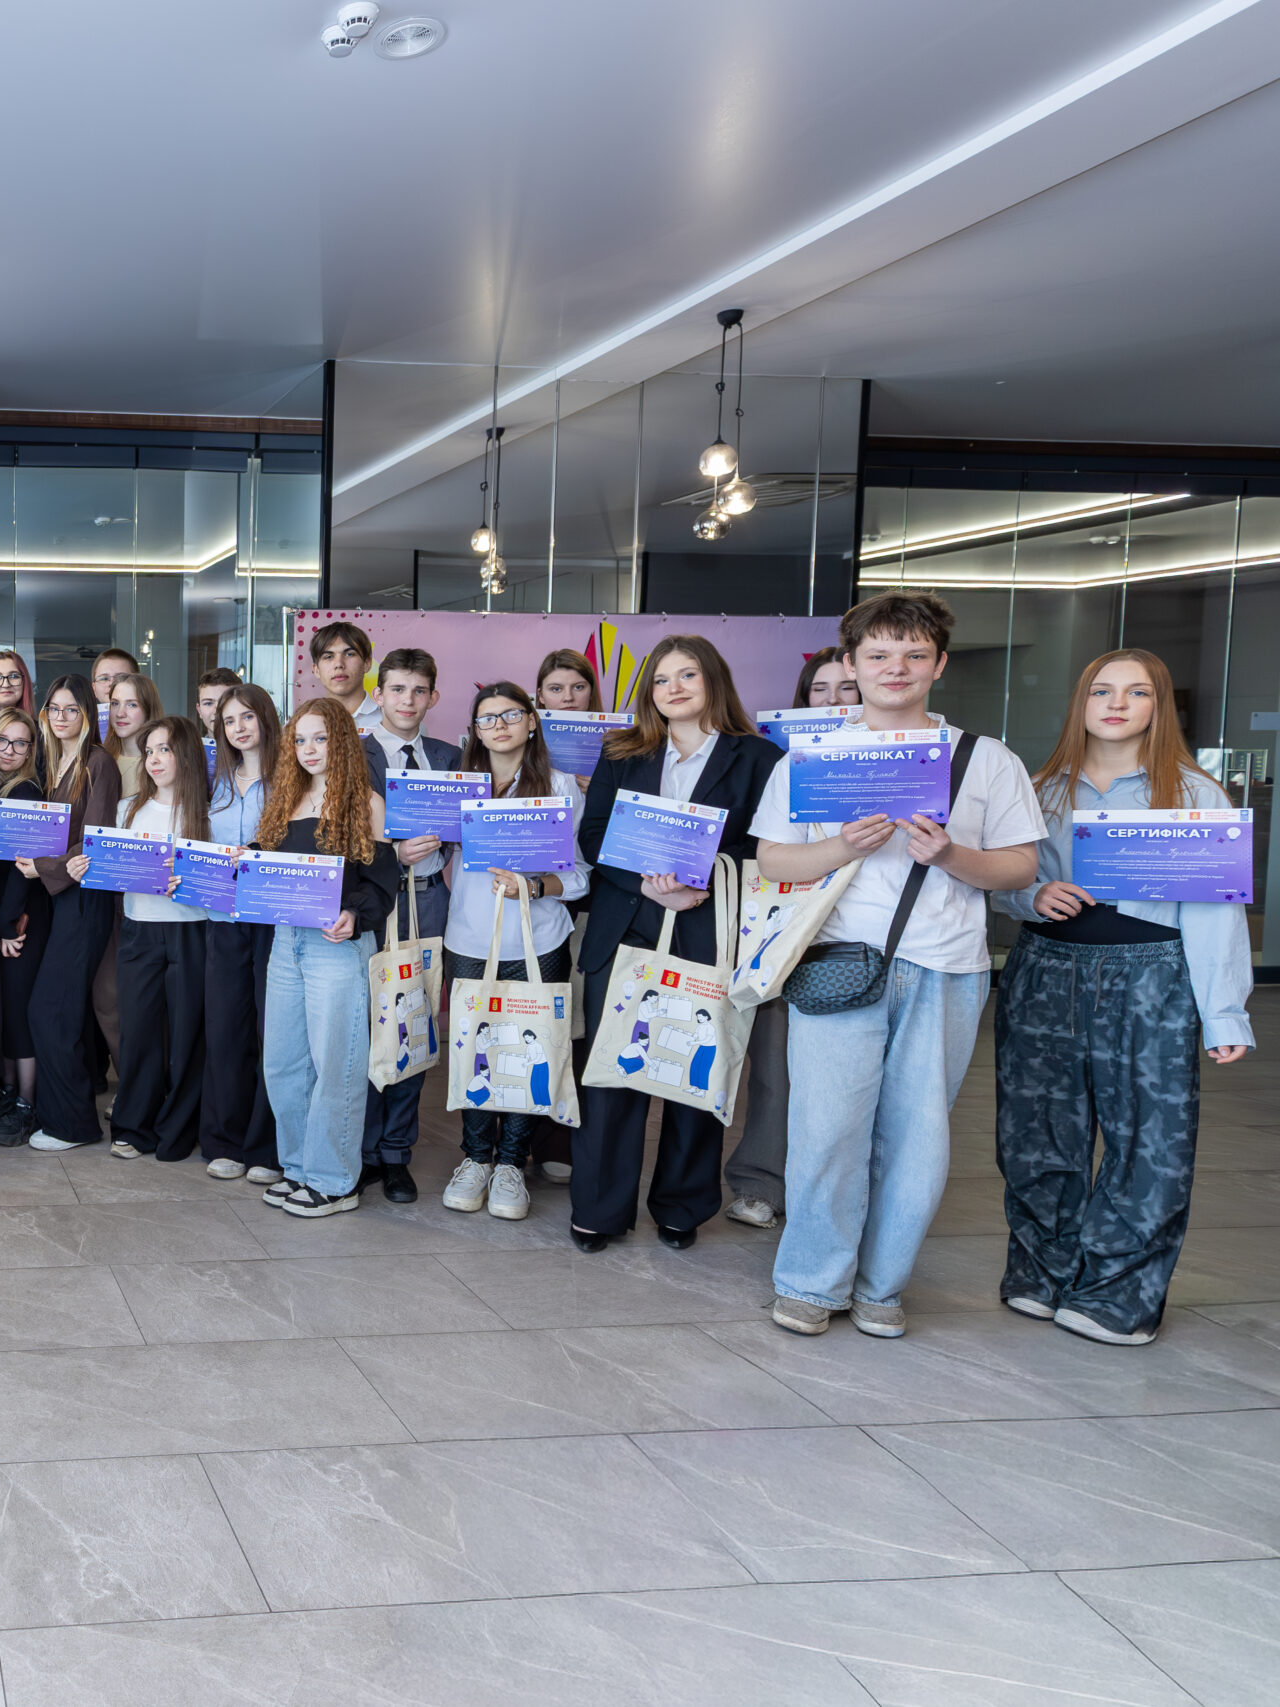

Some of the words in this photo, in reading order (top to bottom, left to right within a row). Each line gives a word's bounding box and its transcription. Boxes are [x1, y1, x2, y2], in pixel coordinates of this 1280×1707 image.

[781, 722, 839, 733] СЕРТИФІК
[820, 750, 916, 762] СЕРТИФІКАТ
[407, 783, 470, 794] СЕРТИФІКАТ
[0, 811, 53, 822] СЕРТИФІКАТ
[482, 812, 549, 822] СЕРТИФІКАТ
[634, 809, 700, 830] СЕРТИФІКАТ
[1106, 827, 1213, 839] СЕРТИФІКАТ
[101, 840, 154, 852] СЕРТИФІКАТ
[258, 865, 321, 878] СЕРТИФІКАТ
[685, 982, 710, 992] FOREIGN
[686, 976, 715, 987] MINISTRY
[692, 989, 722, 1000] DENMARK
